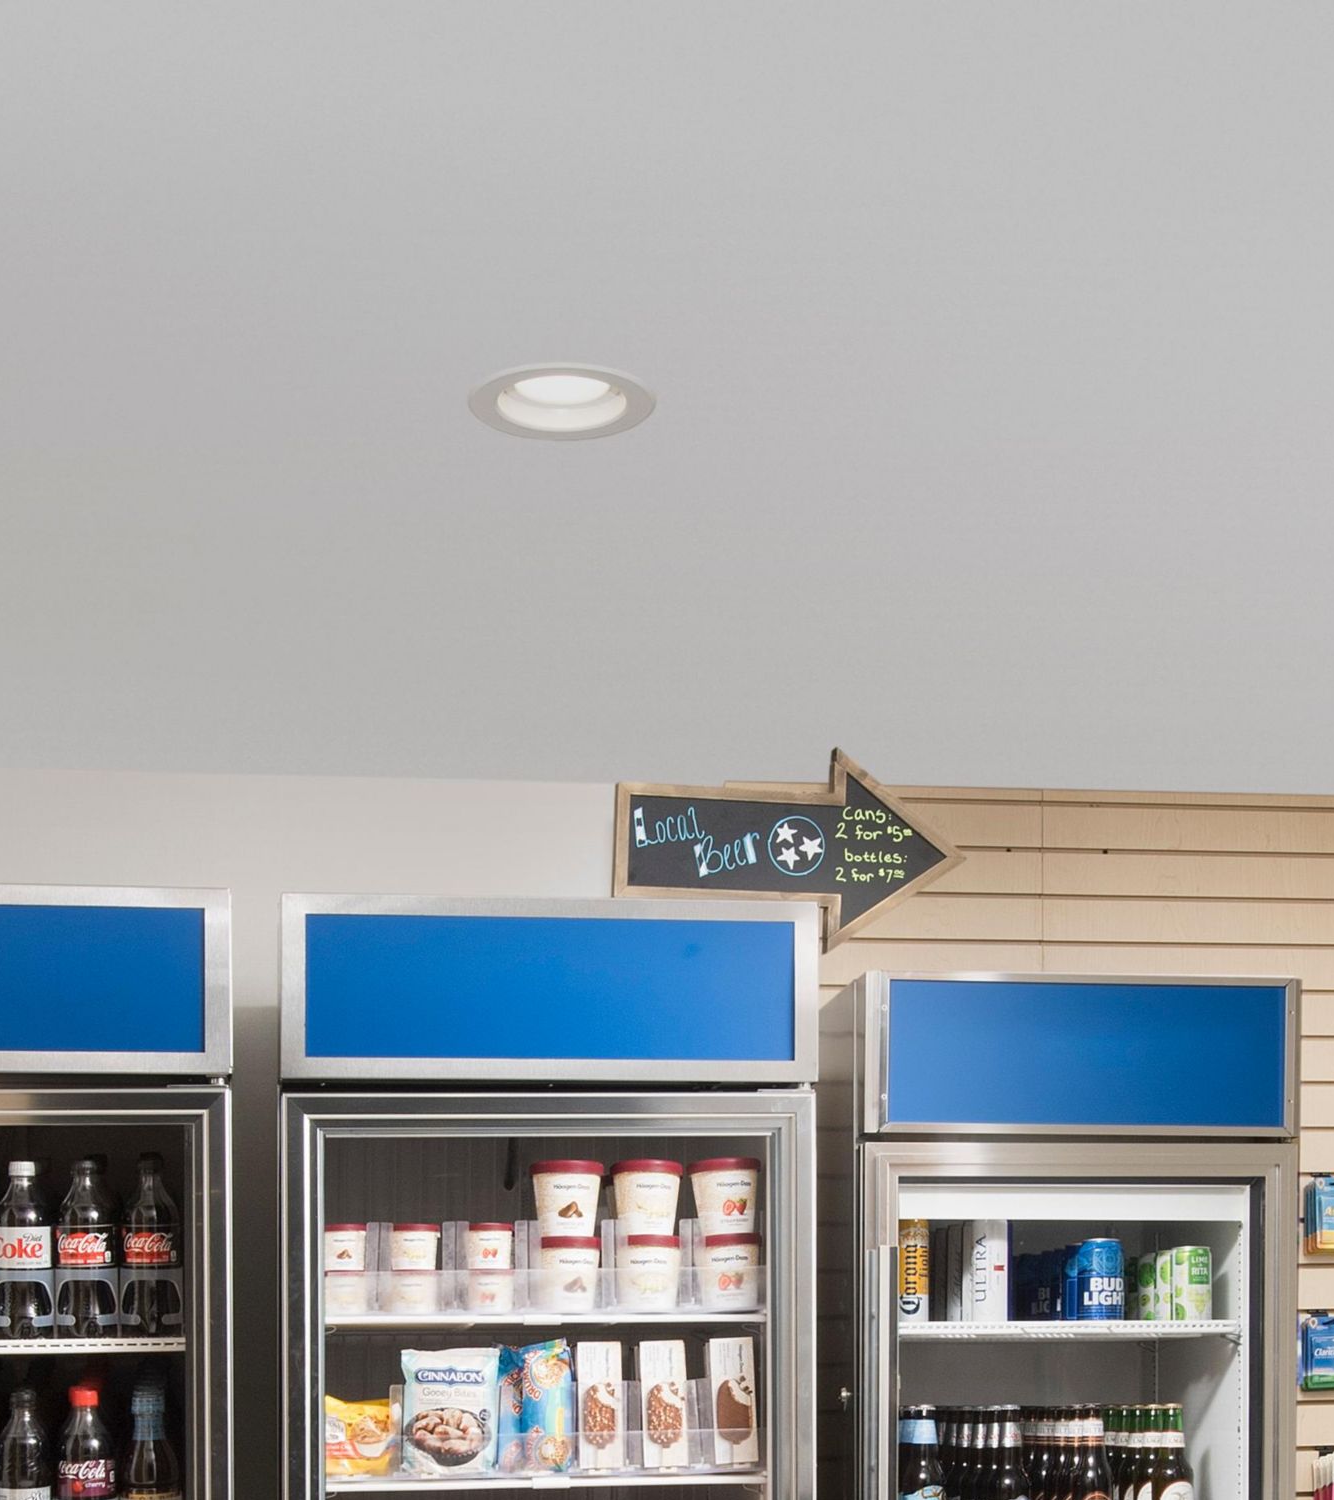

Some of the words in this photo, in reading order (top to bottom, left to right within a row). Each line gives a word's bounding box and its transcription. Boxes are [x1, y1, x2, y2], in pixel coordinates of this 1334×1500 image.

[633, 804, 706, 848] Local
[835, 823, 847, 840] 2
[854, 825, 883, 841] for
[693, 831, 760, 878] Beer
[844, 848, 908, 864] bottles:
[835, 868, 846, 883] 2
[851, 868, 875, 882] for
[57, 1232, 109, 1254] Coca-Cola
[123, 1232, 173, 1253] Coca-Cola
[975, 1233, 987, 1303] ULTRA
[1090, 1277, 1124, 1291] BUD
[417, 1370, 485, 1384] CINNABON
[59, 1459, 106, 1481] Coca-Cola
